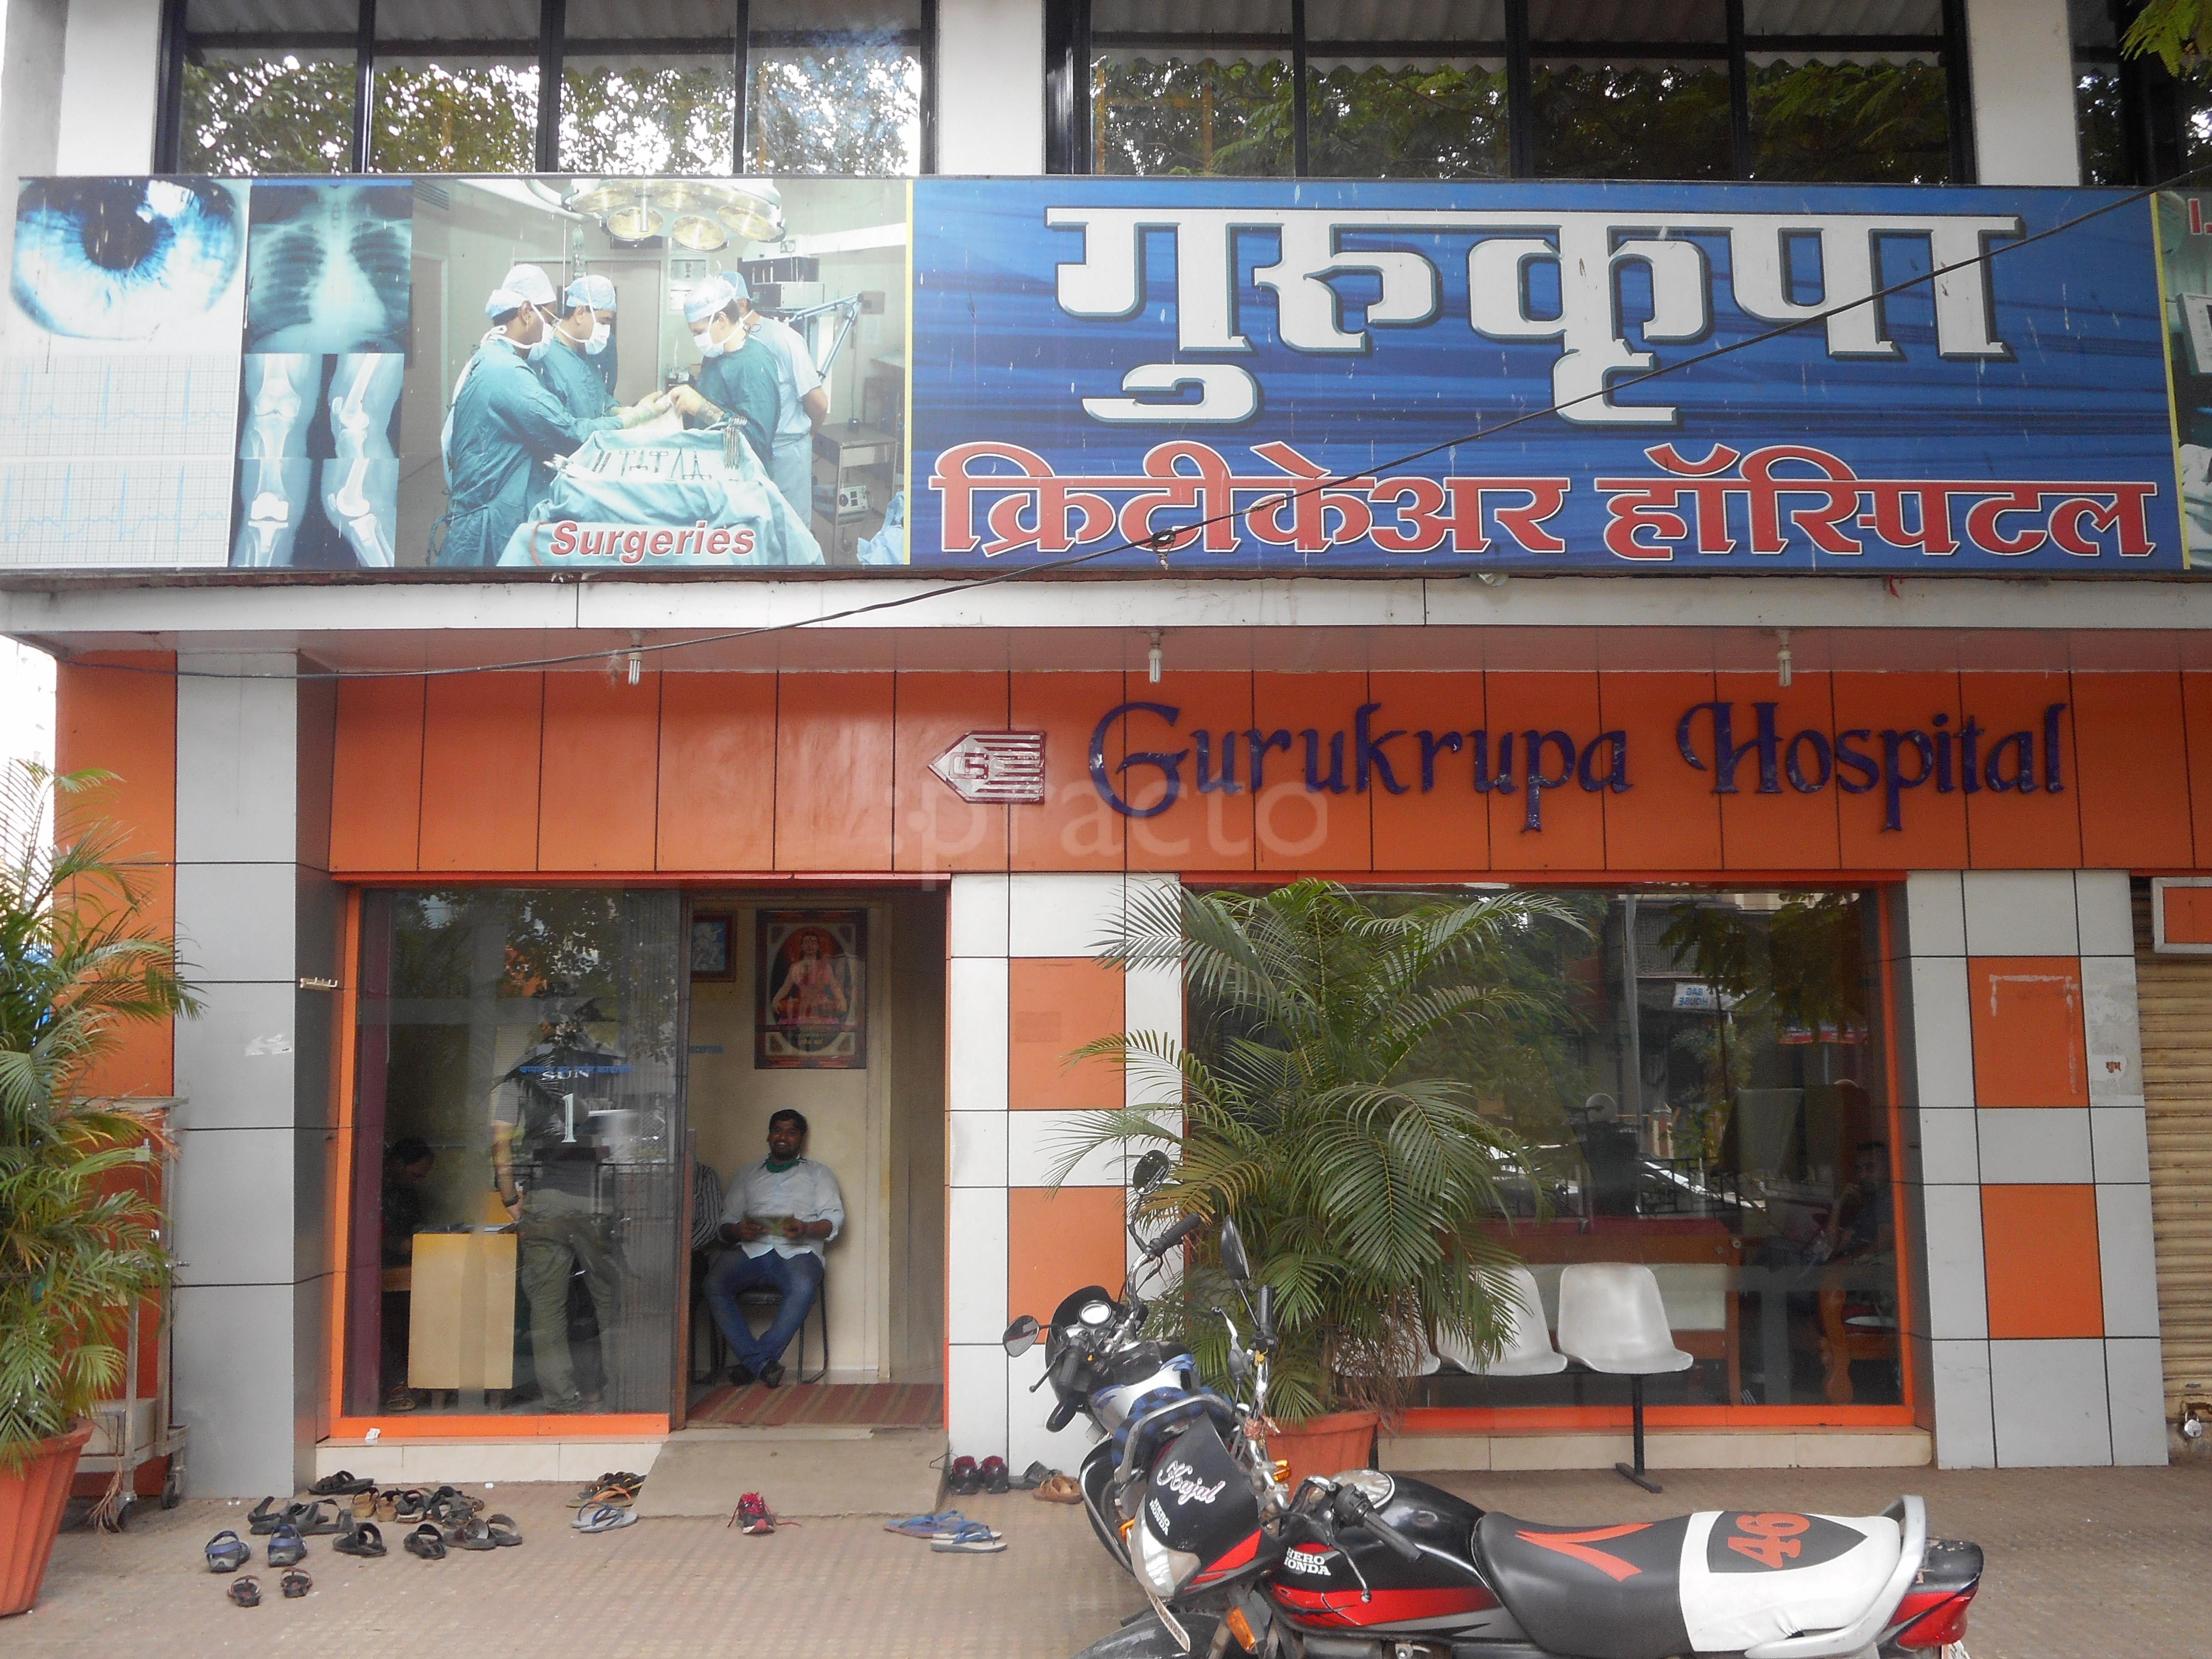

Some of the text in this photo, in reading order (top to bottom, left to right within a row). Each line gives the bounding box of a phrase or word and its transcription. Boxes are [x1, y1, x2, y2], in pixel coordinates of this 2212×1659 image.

[1045, 208, 2027, 427] गुरुकृपा
[929, 440, 2157, 562] क्रिटीकेअर हॉस्पिटल
[549, 520, 755, 564] Surgeries
[1088, 701, 2068, 834] Gurukrupa Hospital
[1157, 1461, 1225, 1505] Kajal
[1149, 1499, 1169, 1536] HONDA
[1154, 1498, 1170, 1527] HERO
[1287, 1547, 1325, 1565] HERO
[1727, 1513, 1811, 1569] 46
